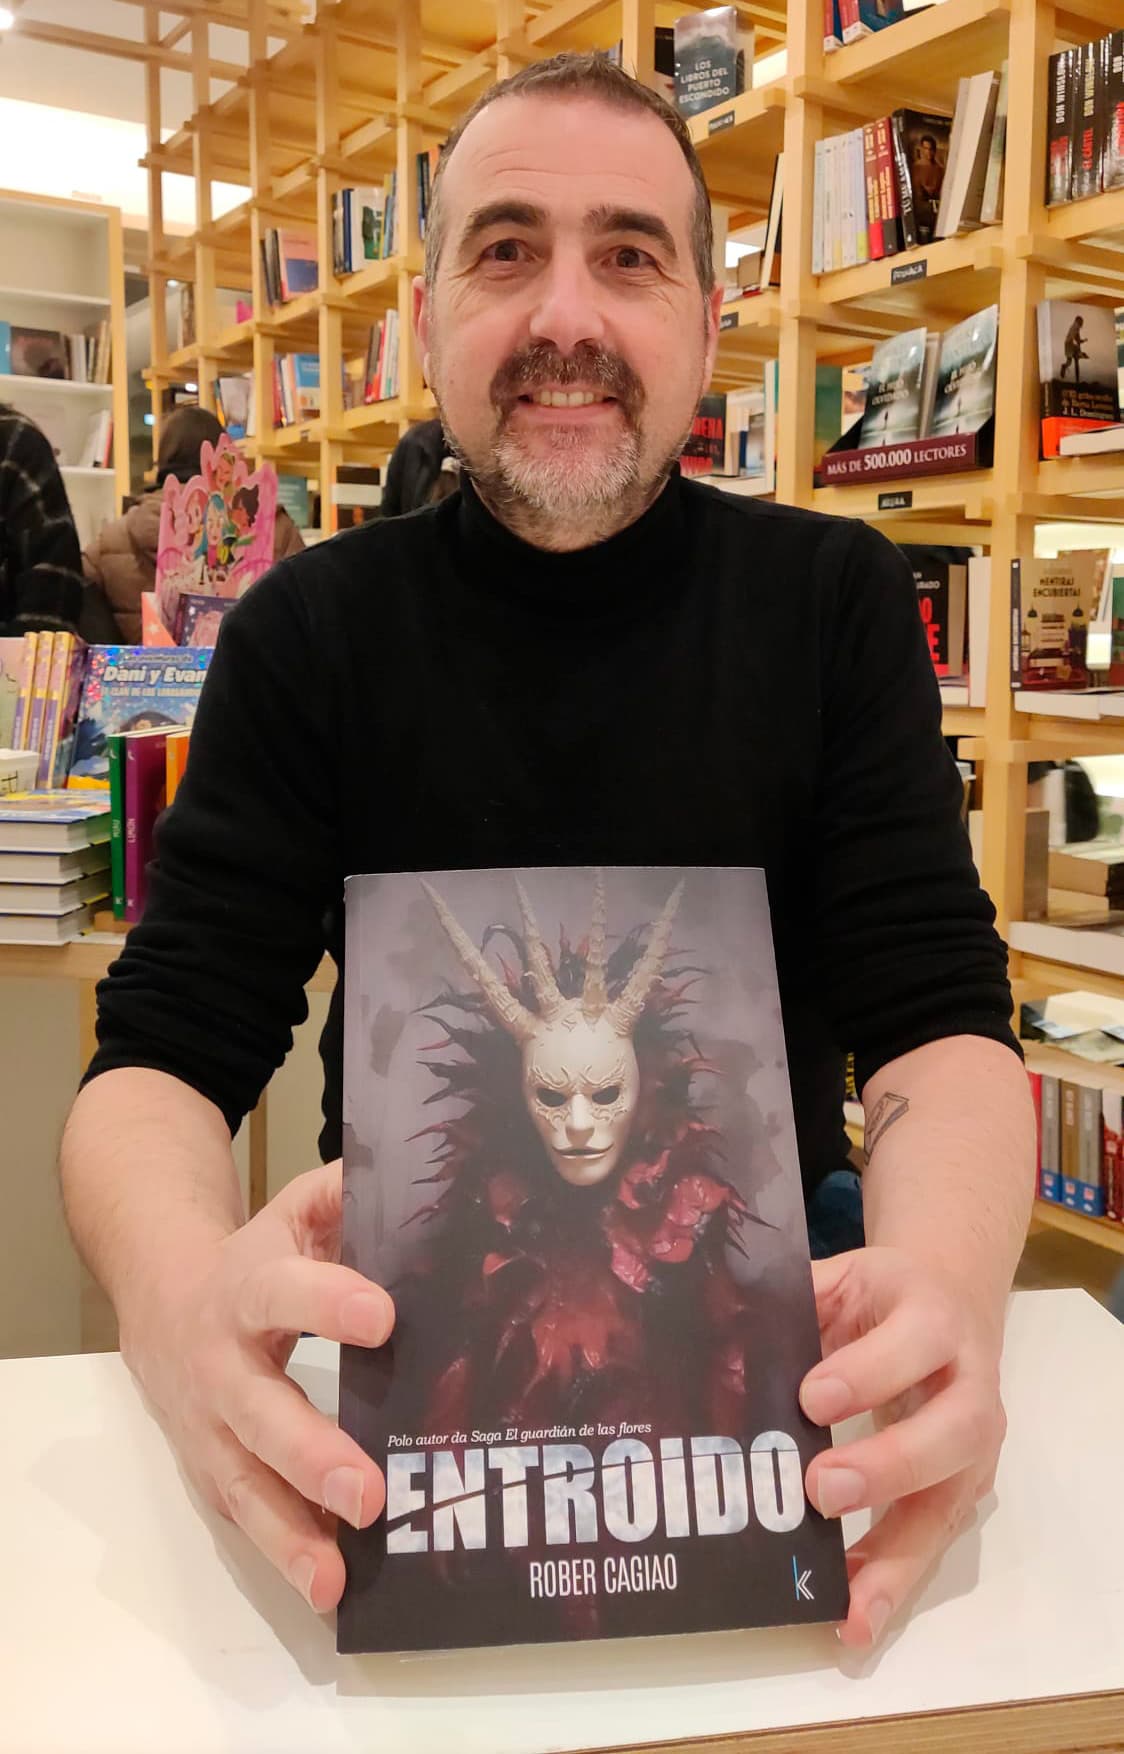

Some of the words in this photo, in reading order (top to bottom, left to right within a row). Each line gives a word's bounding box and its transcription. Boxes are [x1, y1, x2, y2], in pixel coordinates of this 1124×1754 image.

[681, 70, 711, 84] LIBROS
[711, 67, 729, 78] DEL
[695, 60, 711, 71] LOS
[679, 86, 730, 104] ESCONDIDO
[687, 78, 721, 92] PUERTO
[1055, 104, 1065, 124] DON
[827, 462, 847, 475] MÁS
[849, 460, 862, 472] DE
[864, 448, 912, 471] 500.000
[914, 444, 967, 464] LECTORES
[103, 665, 147, 682] Dani
[148, 670, 162, 686] y
[163, 666, 208, 683] Evan
[387, 1434, 413, 1448] Polo
[415, 1434, 449, 1446] autor
[450, 1431, 468, 1443] da
[471, 1430, 502, 1445] Saga
[505, 1428, 518, 1441] El
[520, 1425, 577, 1443] guardián
[579, 1424, 595, 1437] de
[597, 1423, 616, 1436] las
[616, 1421, 652, 1438] flores
[386, 1430, 805, 1554] ENTROIDO
[529, 1558, 597, 1599] ROBER
[603, 1553, 679, 1594] CAGIAO
